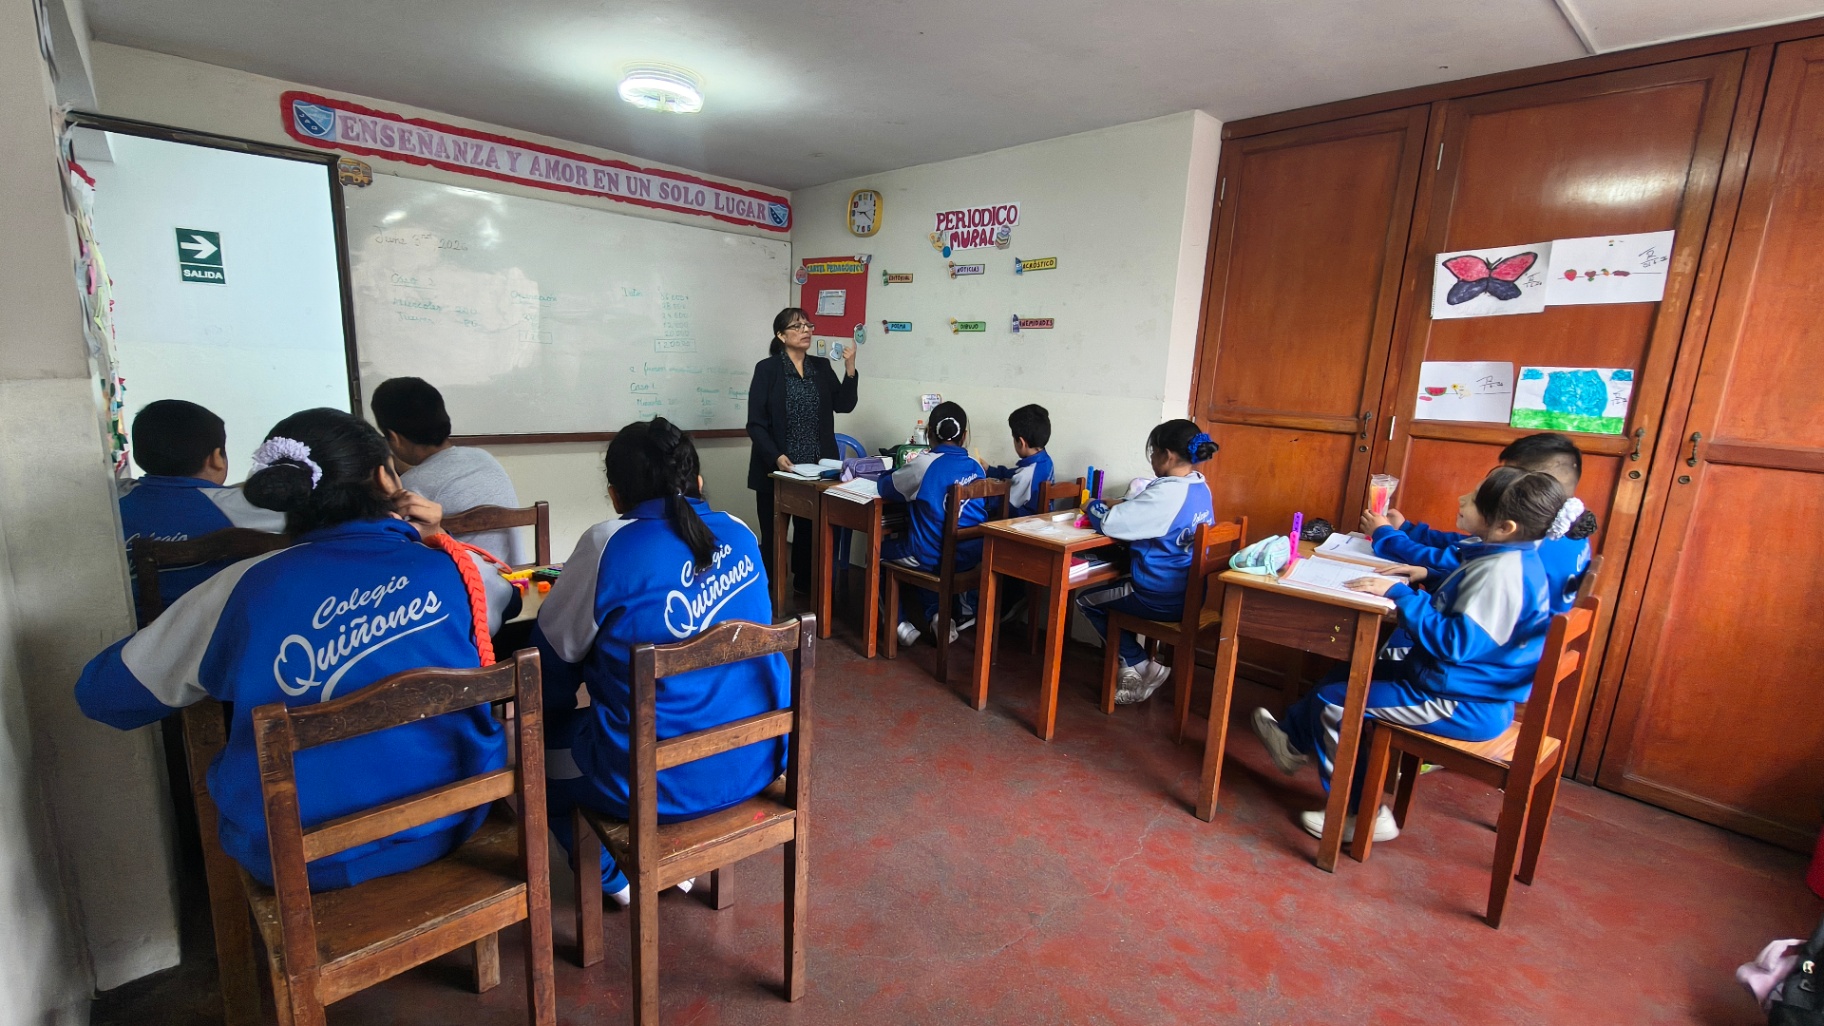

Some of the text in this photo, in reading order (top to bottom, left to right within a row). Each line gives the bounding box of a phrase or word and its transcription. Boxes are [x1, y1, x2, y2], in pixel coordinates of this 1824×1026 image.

[338, 115, 766, 221] ENSEÑANZA Y AMOR EN UN SOLO LUGAR
[936, 205, 1018, 231] PERIODICO
[950, 228, 995, 250] MURAL
[183, 269, 224, 279] SALIDA
[312, 575, 410, 630] Colegio
[664, 555, 754, 639] Quiñones
[273, 590, 442, 696] Quiñones
